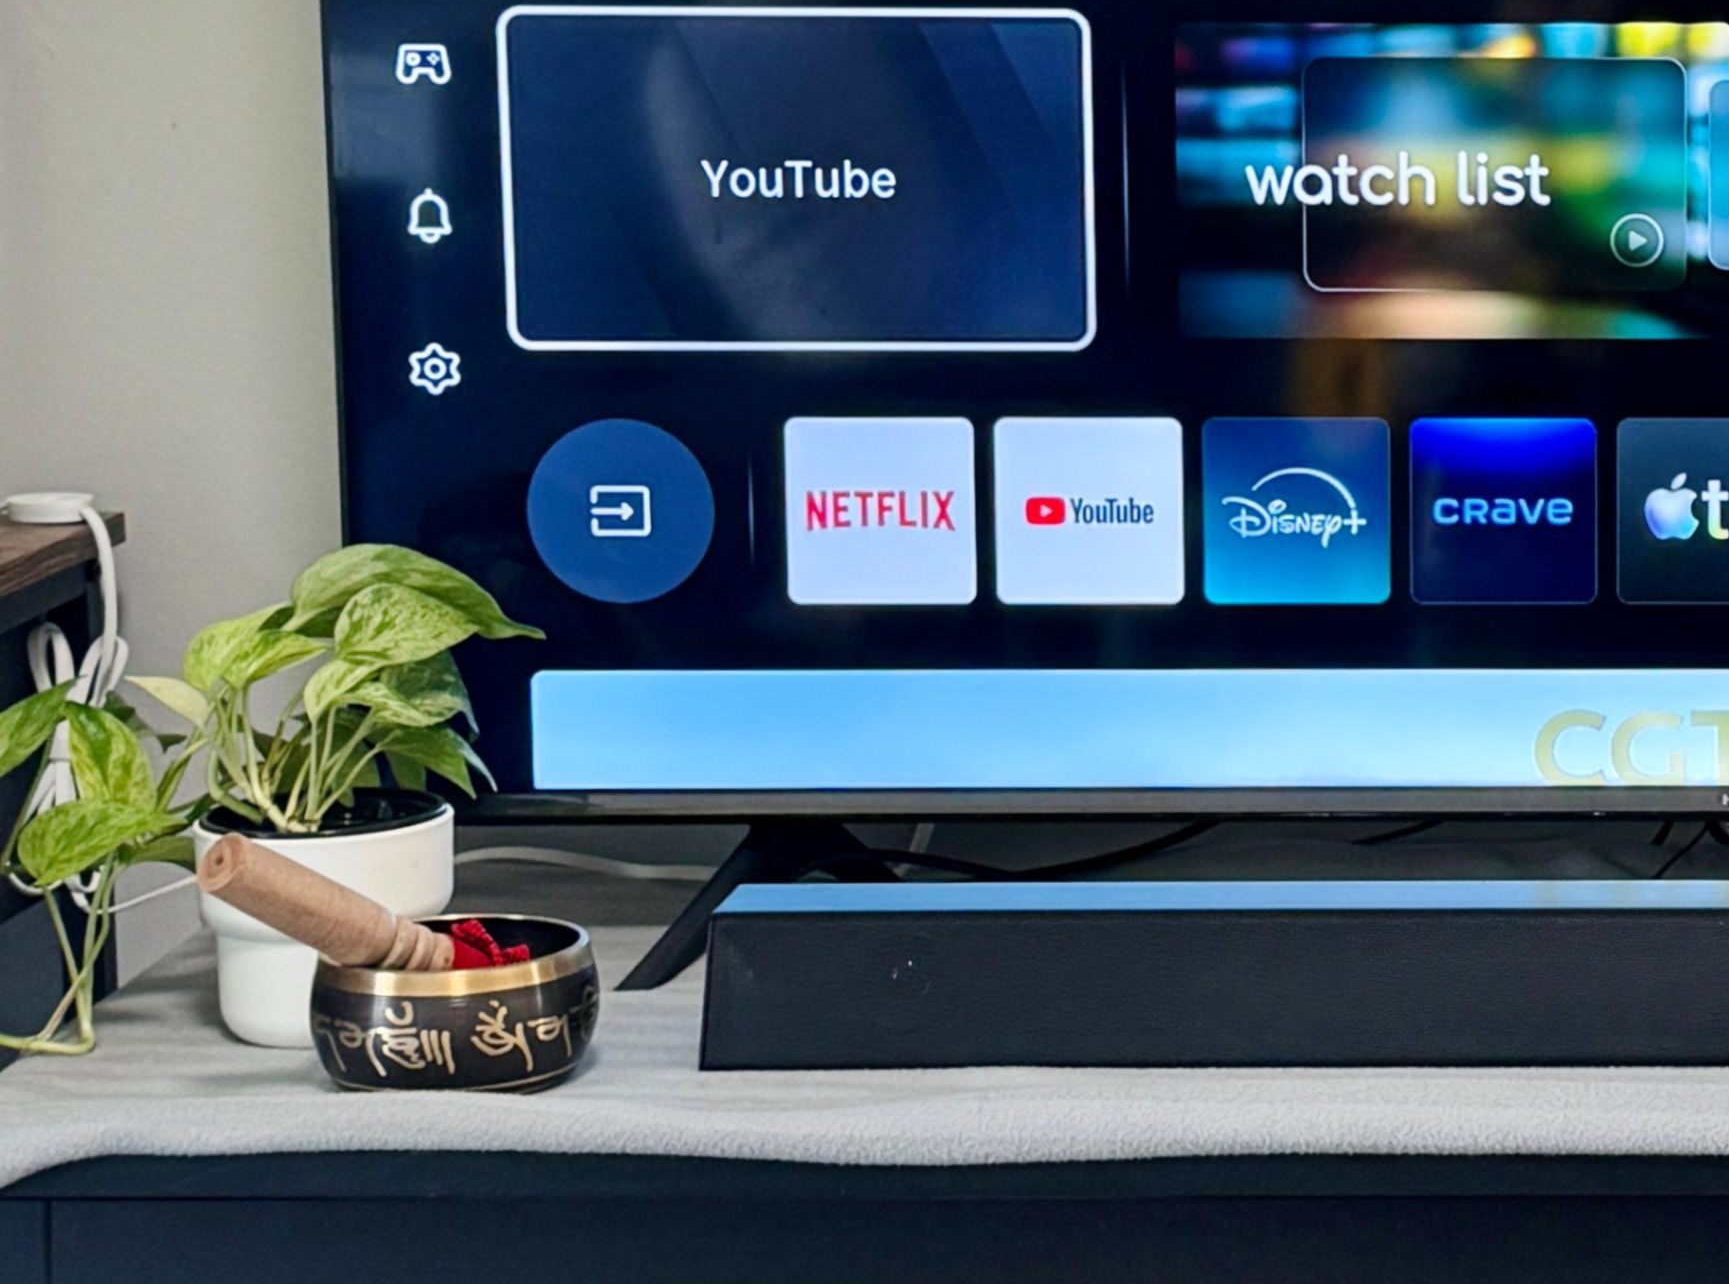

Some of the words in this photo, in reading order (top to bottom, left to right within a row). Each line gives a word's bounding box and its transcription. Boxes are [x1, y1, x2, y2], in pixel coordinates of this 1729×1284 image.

[700, 159, 897, 199] YouTube
[1244, 151, 1437, 207] watch
[1457, 150, 1551, 207] list
[805, 490, 956, 532] NETFLIX
[1070, 497, 1155, 525] YouTube
